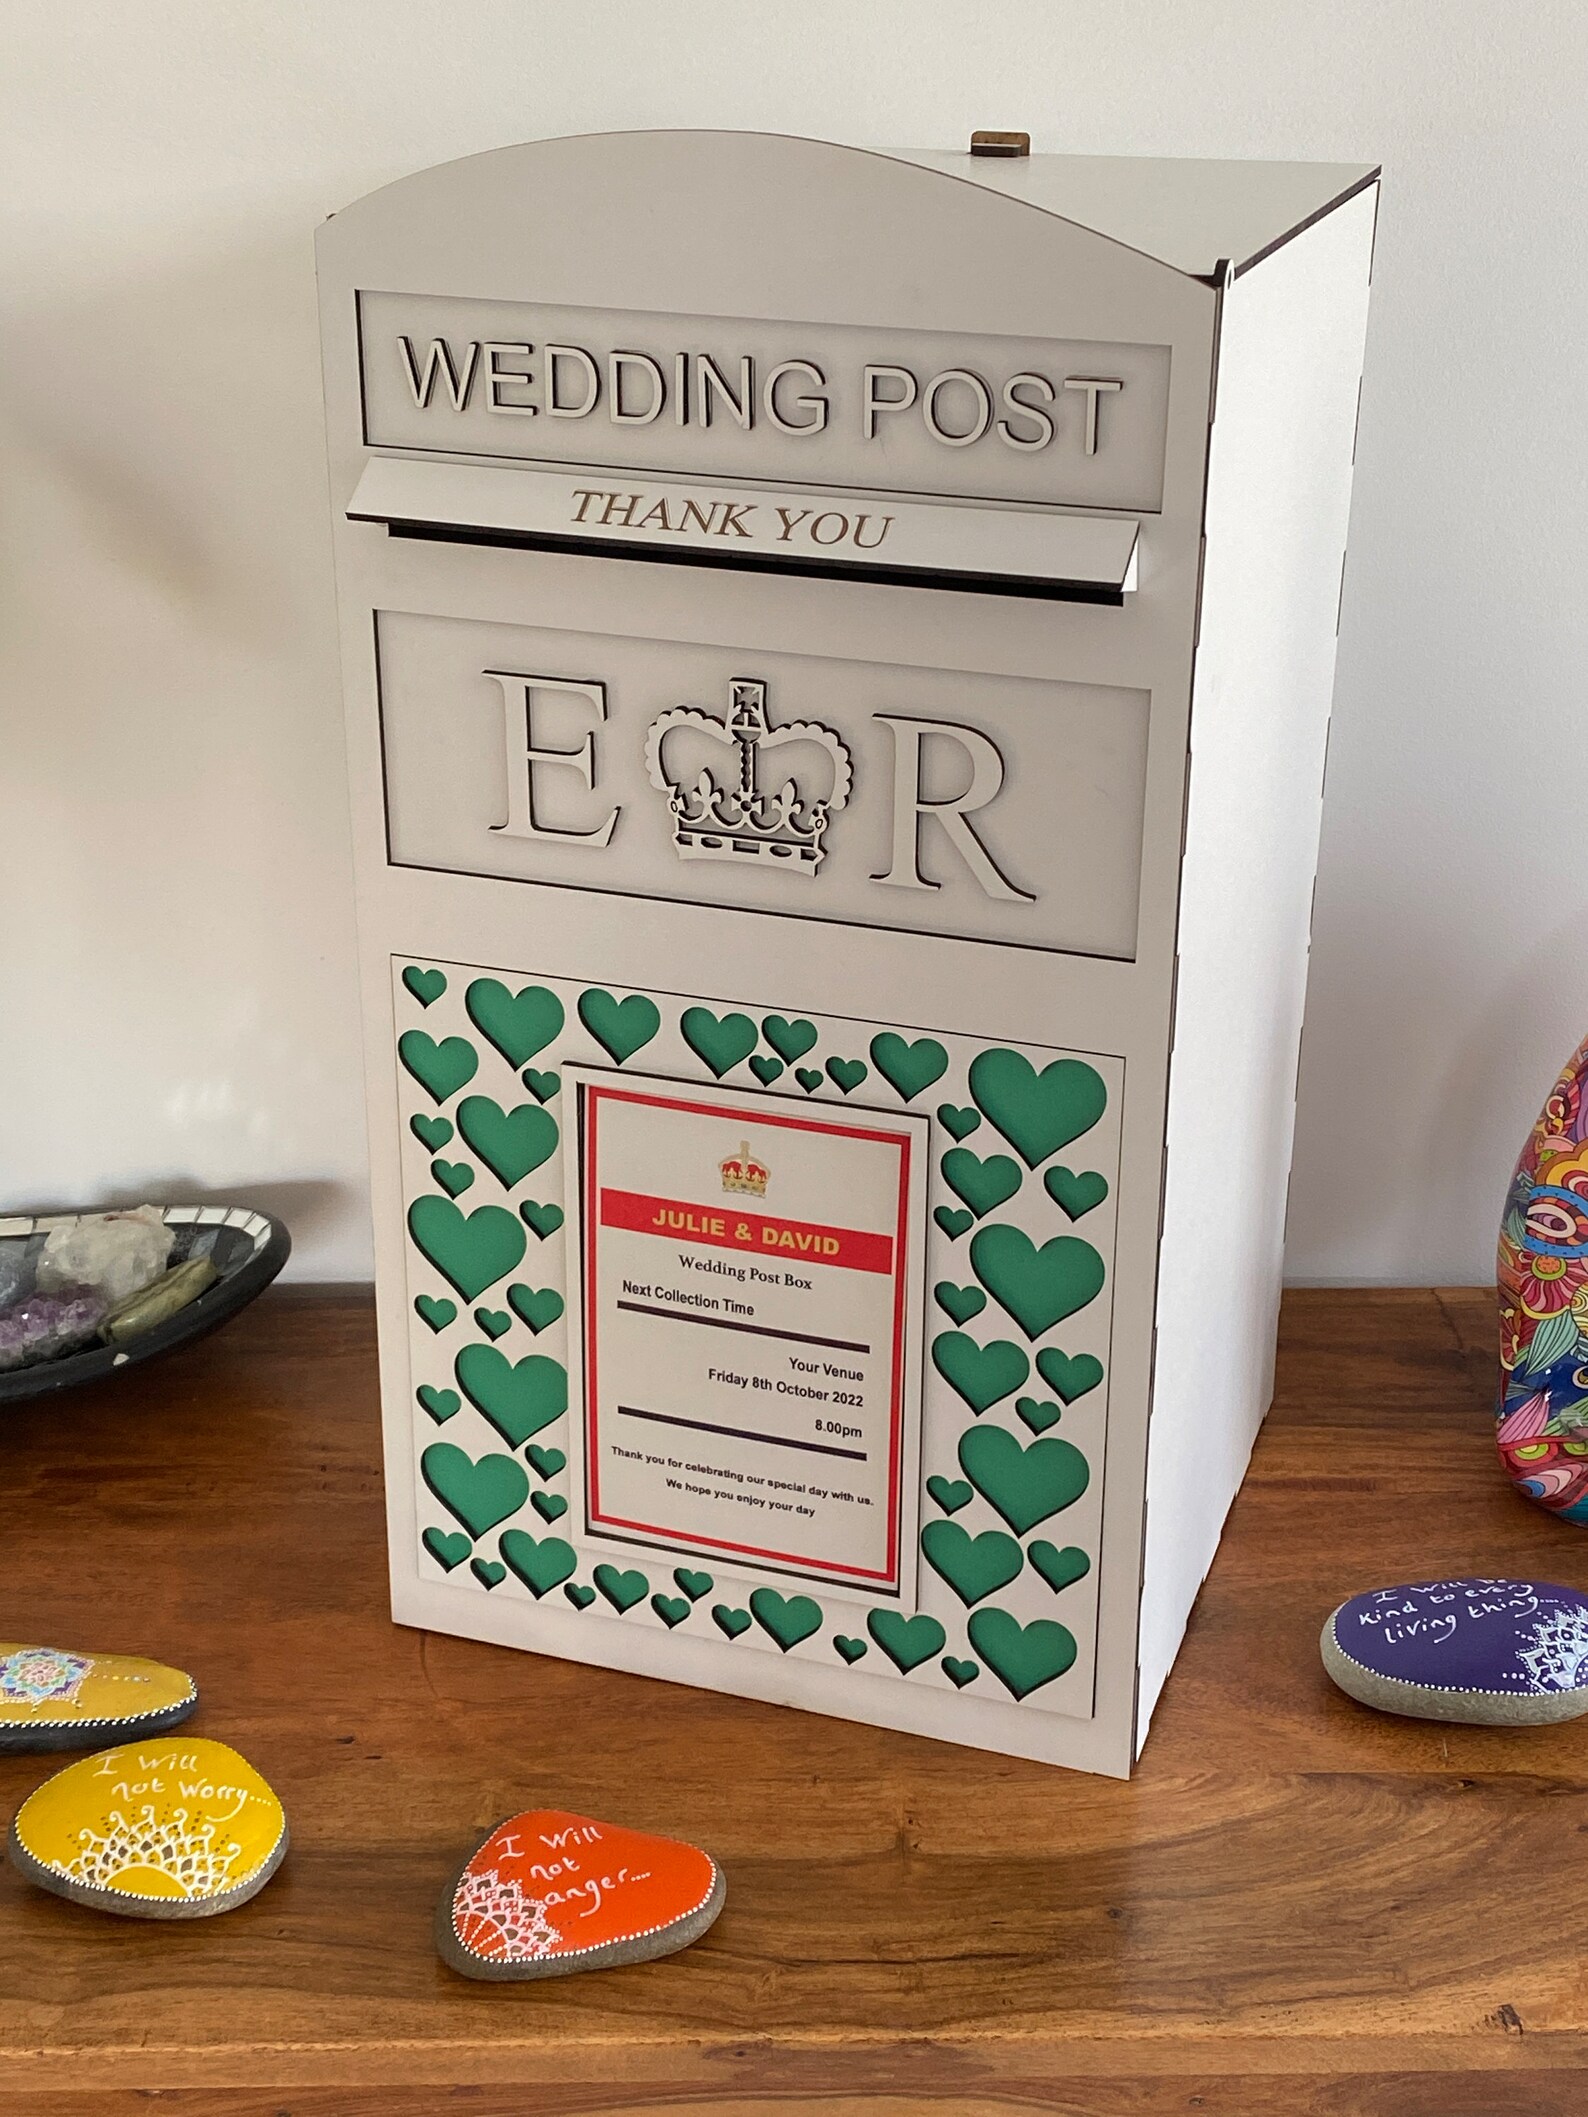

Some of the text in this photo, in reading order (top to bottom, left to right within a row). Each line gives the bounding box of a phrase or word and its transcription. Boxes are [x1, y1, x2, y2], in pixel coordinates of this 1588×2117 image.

[396, 336, 1124, 457] WEDDING POST
[569, 489, 897, 550] THANK YOU
[480, 668, 1038, 903] E R
[651, 1208, 841, 1257] JULIE & DAVID
[678, 1254, 814, 1291] Wedding Post Box
[622, 1279, 755, 1317] Next Collection Time
[788, 1357, 865, 1382] Your Venue
[708, 1368, 864, 1408] Friday 8th October 2022
[814, 1419, 863, 1439] 8.00pm
[611, 1446, 875, 1507] Thank you for celebrating our special day with us.
[666, 1478, 816, 1518] We hope you enjoy your day
[1372, 1588, 1398, 1604] I
[1430, 1593, 1456, 1604] to
[1465, 1584, 1534, 1598] every
[1384, 1614, 1457, 1645] living
[92, 1754, 124, 1777] I
[111, 1777, 166, 1802] not
[495, 1834, 525, 1861] I
[530, 1857, 580, 1881] not
